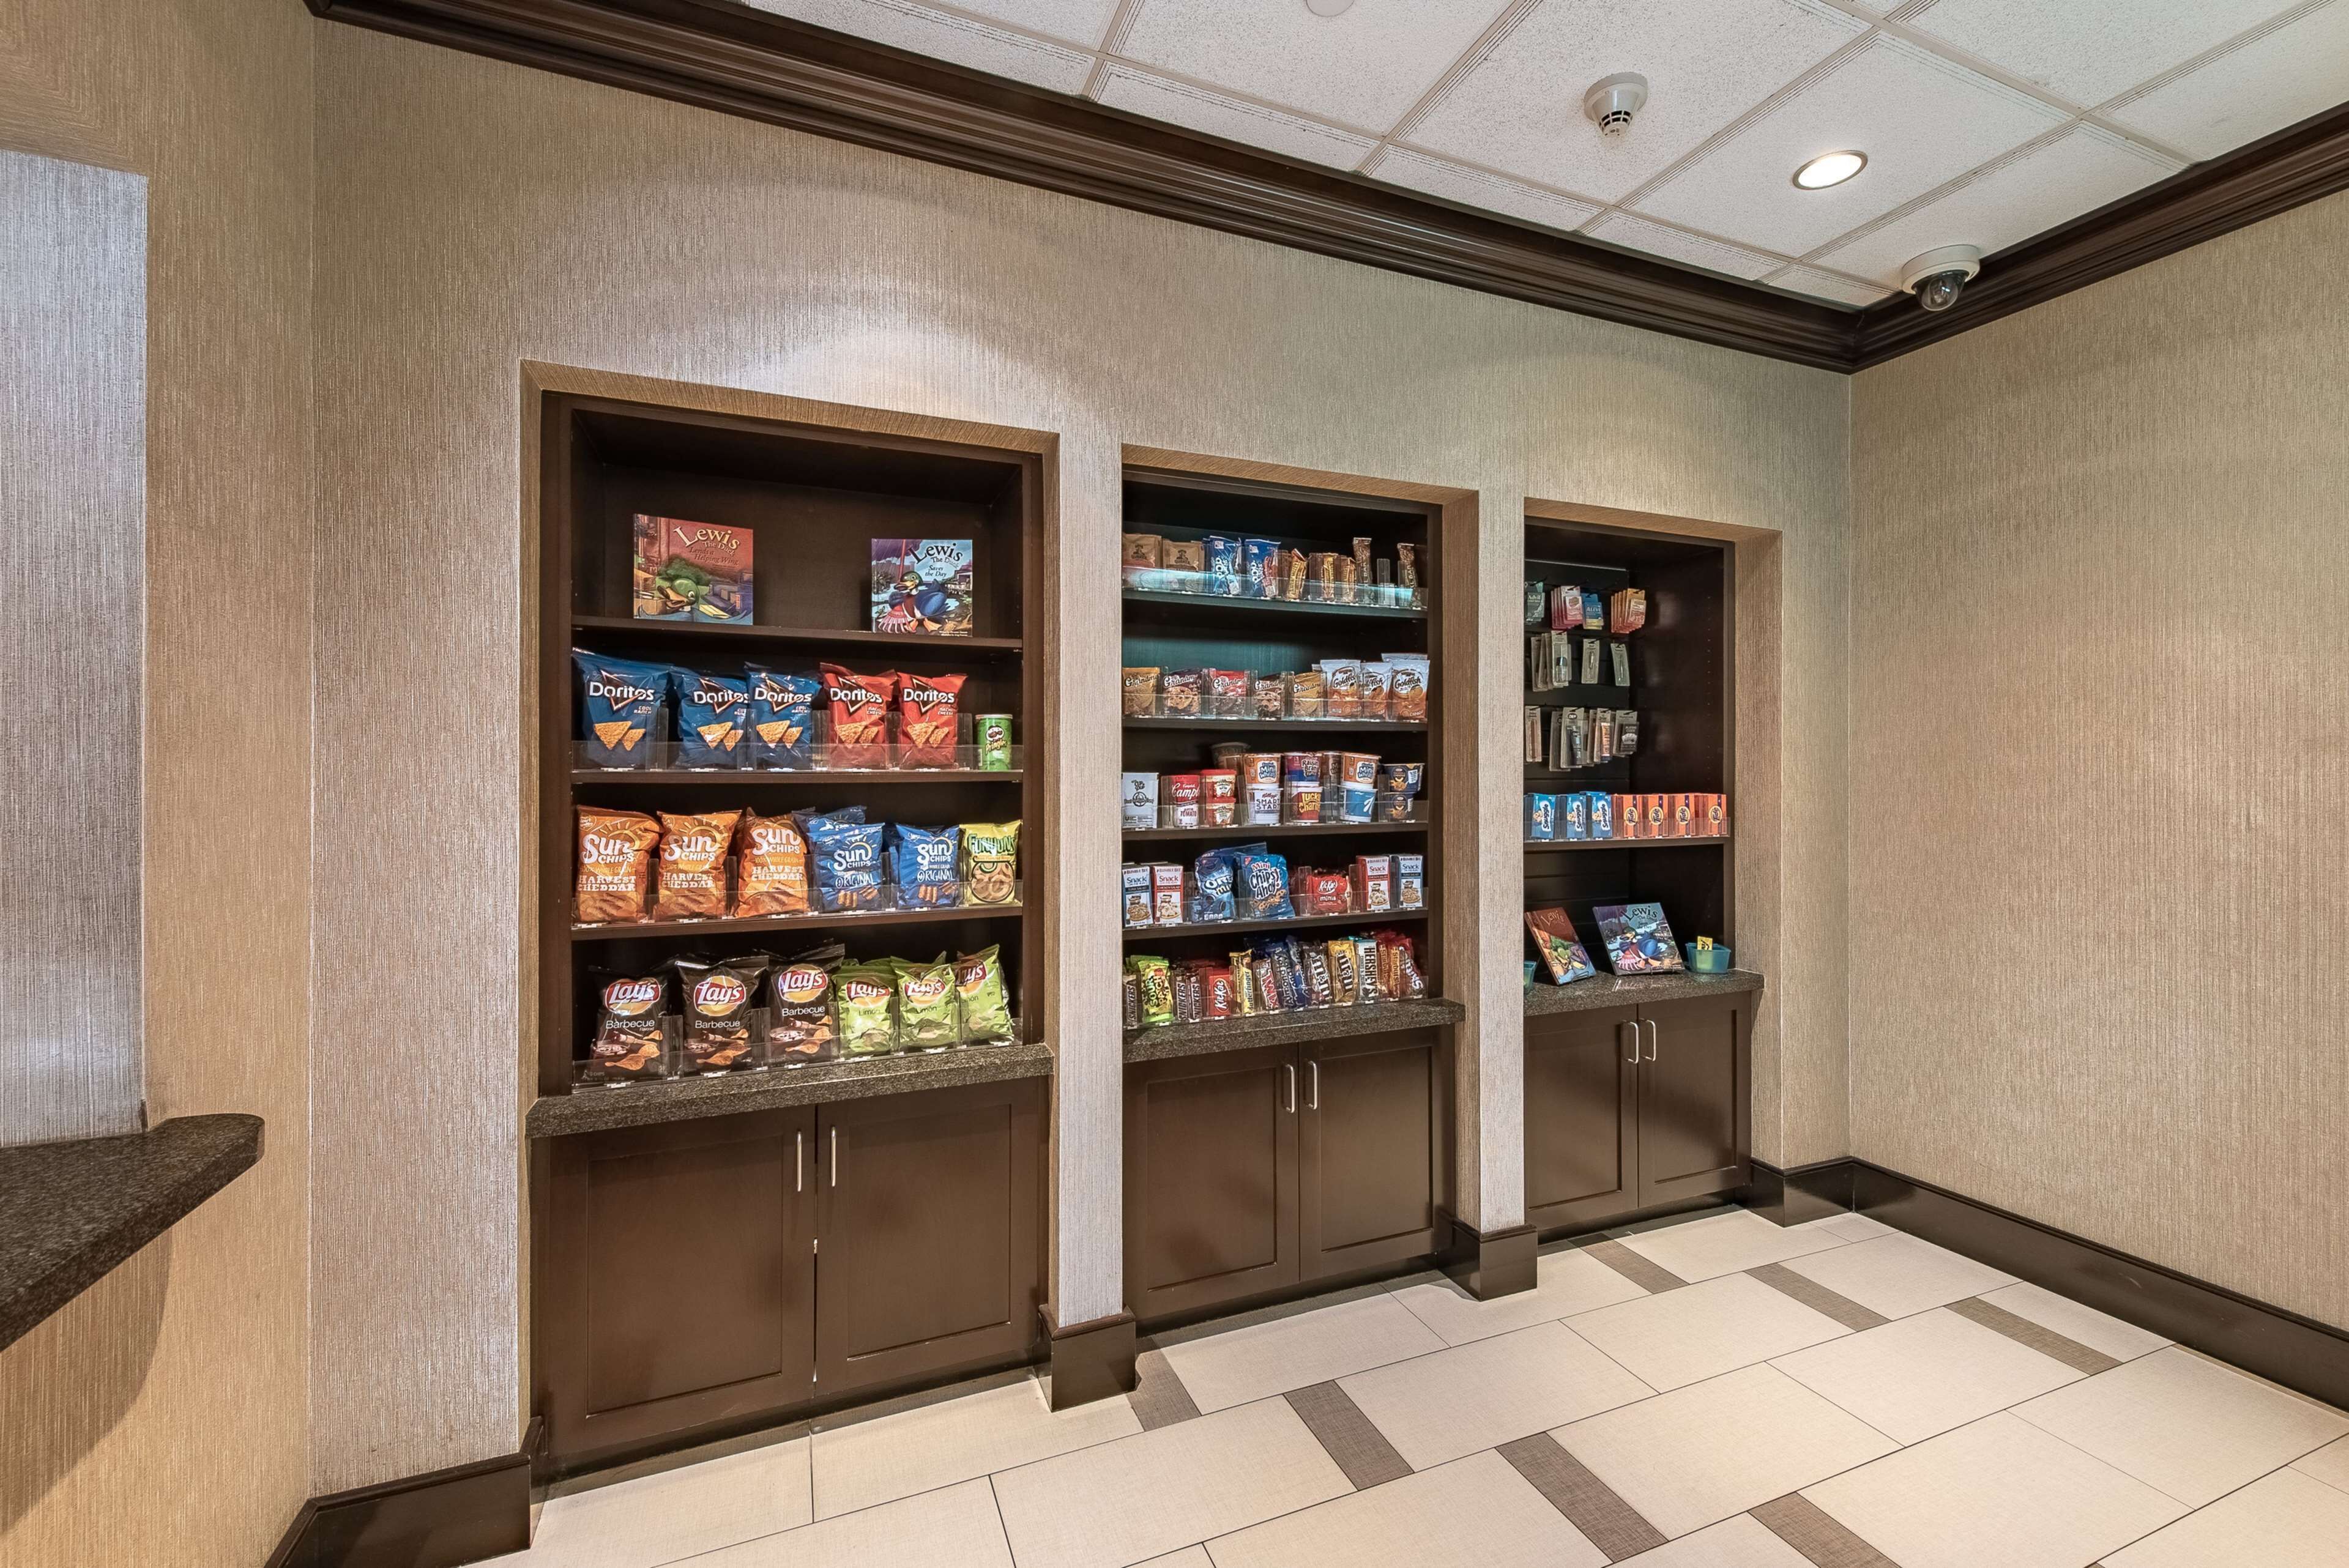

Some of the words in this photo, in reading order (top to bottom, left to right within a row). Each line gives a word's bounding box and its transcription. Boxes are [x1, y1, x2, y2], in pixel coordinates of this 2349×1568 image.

[674, 526, 739, 549] Lewis
[718, 542, 736, 557] Duck
[908, 543, 963, 564] Lewis
[694, 554, 720, 563] Helping
[721, 557, 739, 565] Wing
[1394, 676, 1421, 688] Goldfish
[589, 682, 655, 700] Doritos
[693, 690, 750, 704] Doritos
[754, 688, 812, 702] Doritos
[830, 688, 883, 703] Doritos
[904, 689, 955, 703] Doritos
[582, 834, 633, 864] Sun
[664, 835, 717, 861] Sun
[751, 828, 801, 855] Sun
[768, 845, 800, 853] CHIPS
[598, 853, 635, 863] CHIPS
[681, 852, 715, 861] CHIPS
[833, 849, 870, 871] Sun
[917, 844, 951, 864] Sun
[1251, 861, 1270, 871] Mini
[836, 874, 877, 888] ORIGINAL
[917, 869, 956, 882] ORIGINAL
[1204, 875, 1233, 889] ORE
[1249, 869, 1276, 890] Chips
[1620, 905, 1658, 921] Lewis
[609, 981, 657, 1003] Lay's
[1145, 978, 1158, 1006] SOUR
[1153, 975, 1166, 1005] PATCH
[1177, 983, 1187, 1020] SNICKERS
[1192, 984, 1201, 1020] SNICKERS
[782, 1006, 825, 1017] Barbecue
[606, 1019, 655, 1029] Barbecue
[695, 1020, 740, 1028] Barbecue
